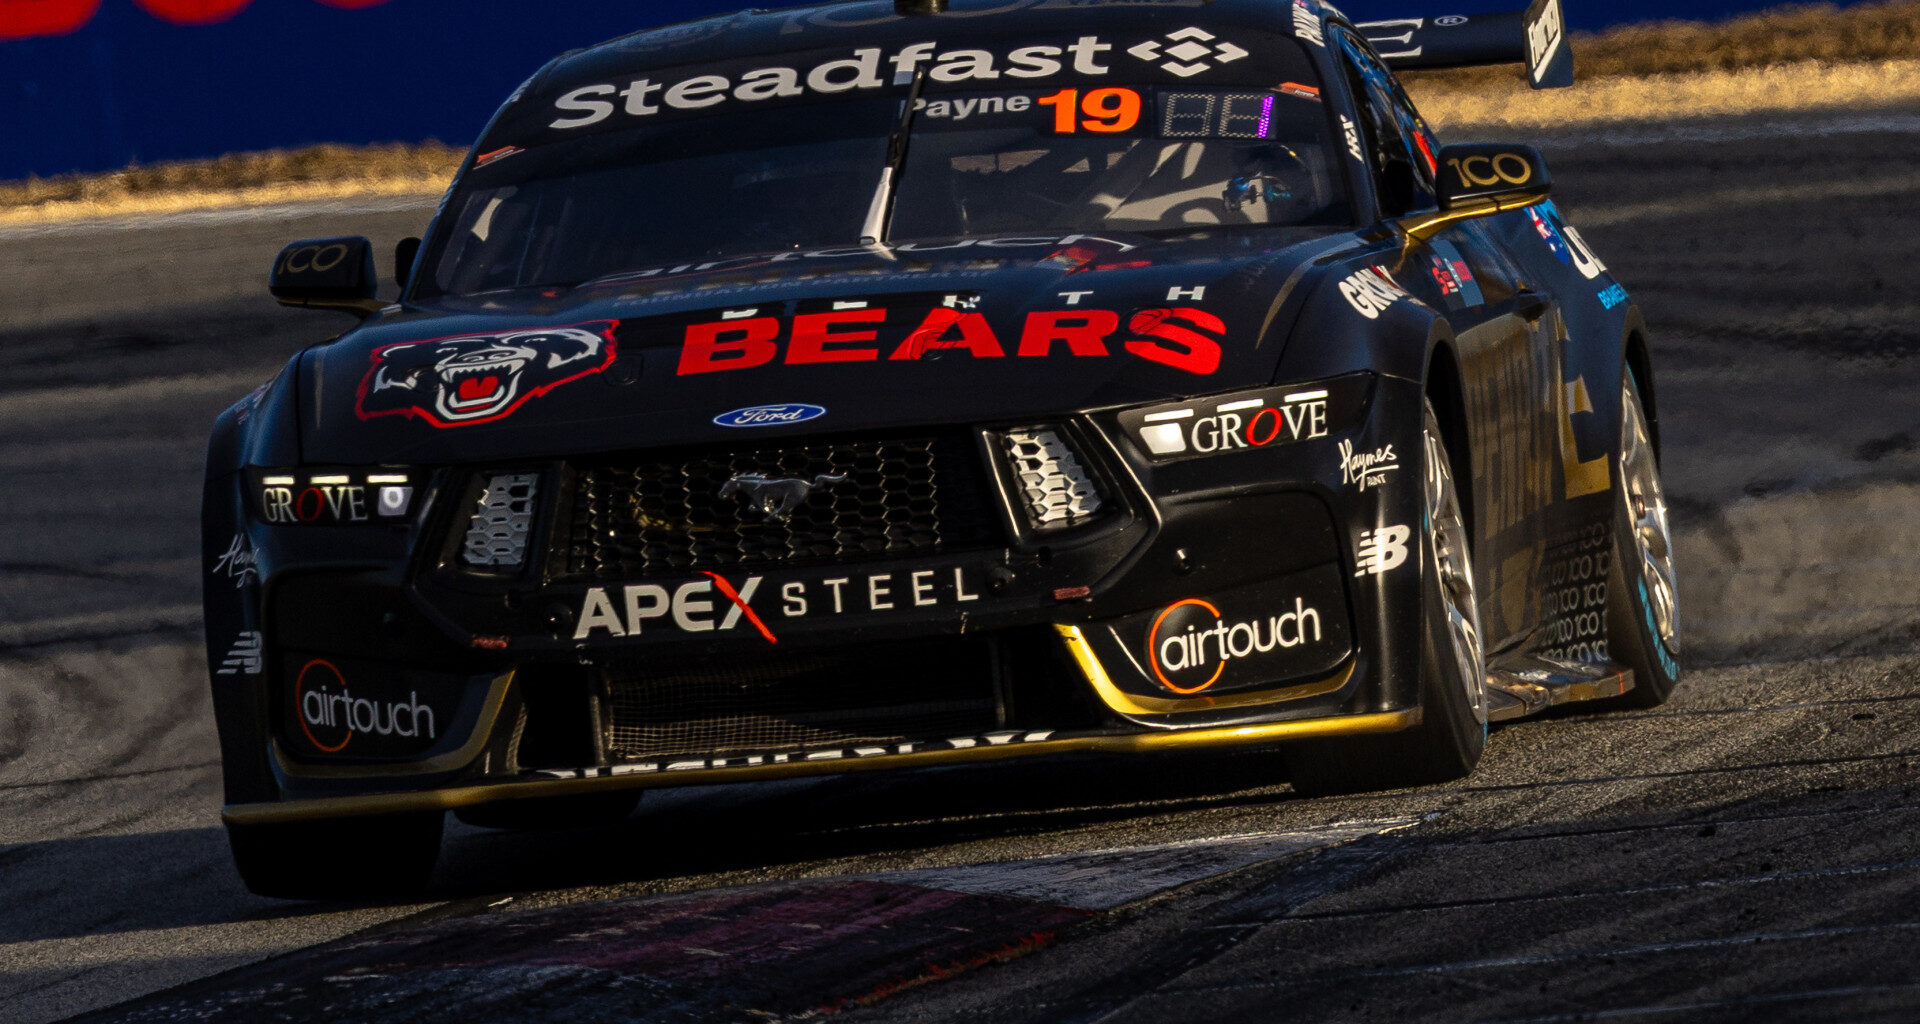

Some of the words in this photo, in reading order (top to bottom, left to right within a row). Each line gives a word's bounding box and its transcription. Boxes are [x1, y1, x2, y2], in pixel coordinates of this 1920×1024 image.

[549, 36, 1111, 129] Steadfast
[900, 95, 1031, 121] Payne
[1037, 87, 1141, 134] 19
[676, 307, 1226, 376] BEARS
[734, 406, 804, 425] Ford
[1191, 399, 1328, 454] GROVE
[1338, 438, 1399, 493] Haymes
[262, 486, 368, 523] GROVE
[573, 570, 777, 645] APEX
[781, 566, 979, 617] STEEL
[1161, 596, 1321, 672] airtouch
[303, 685, 435, 740] airtouch
